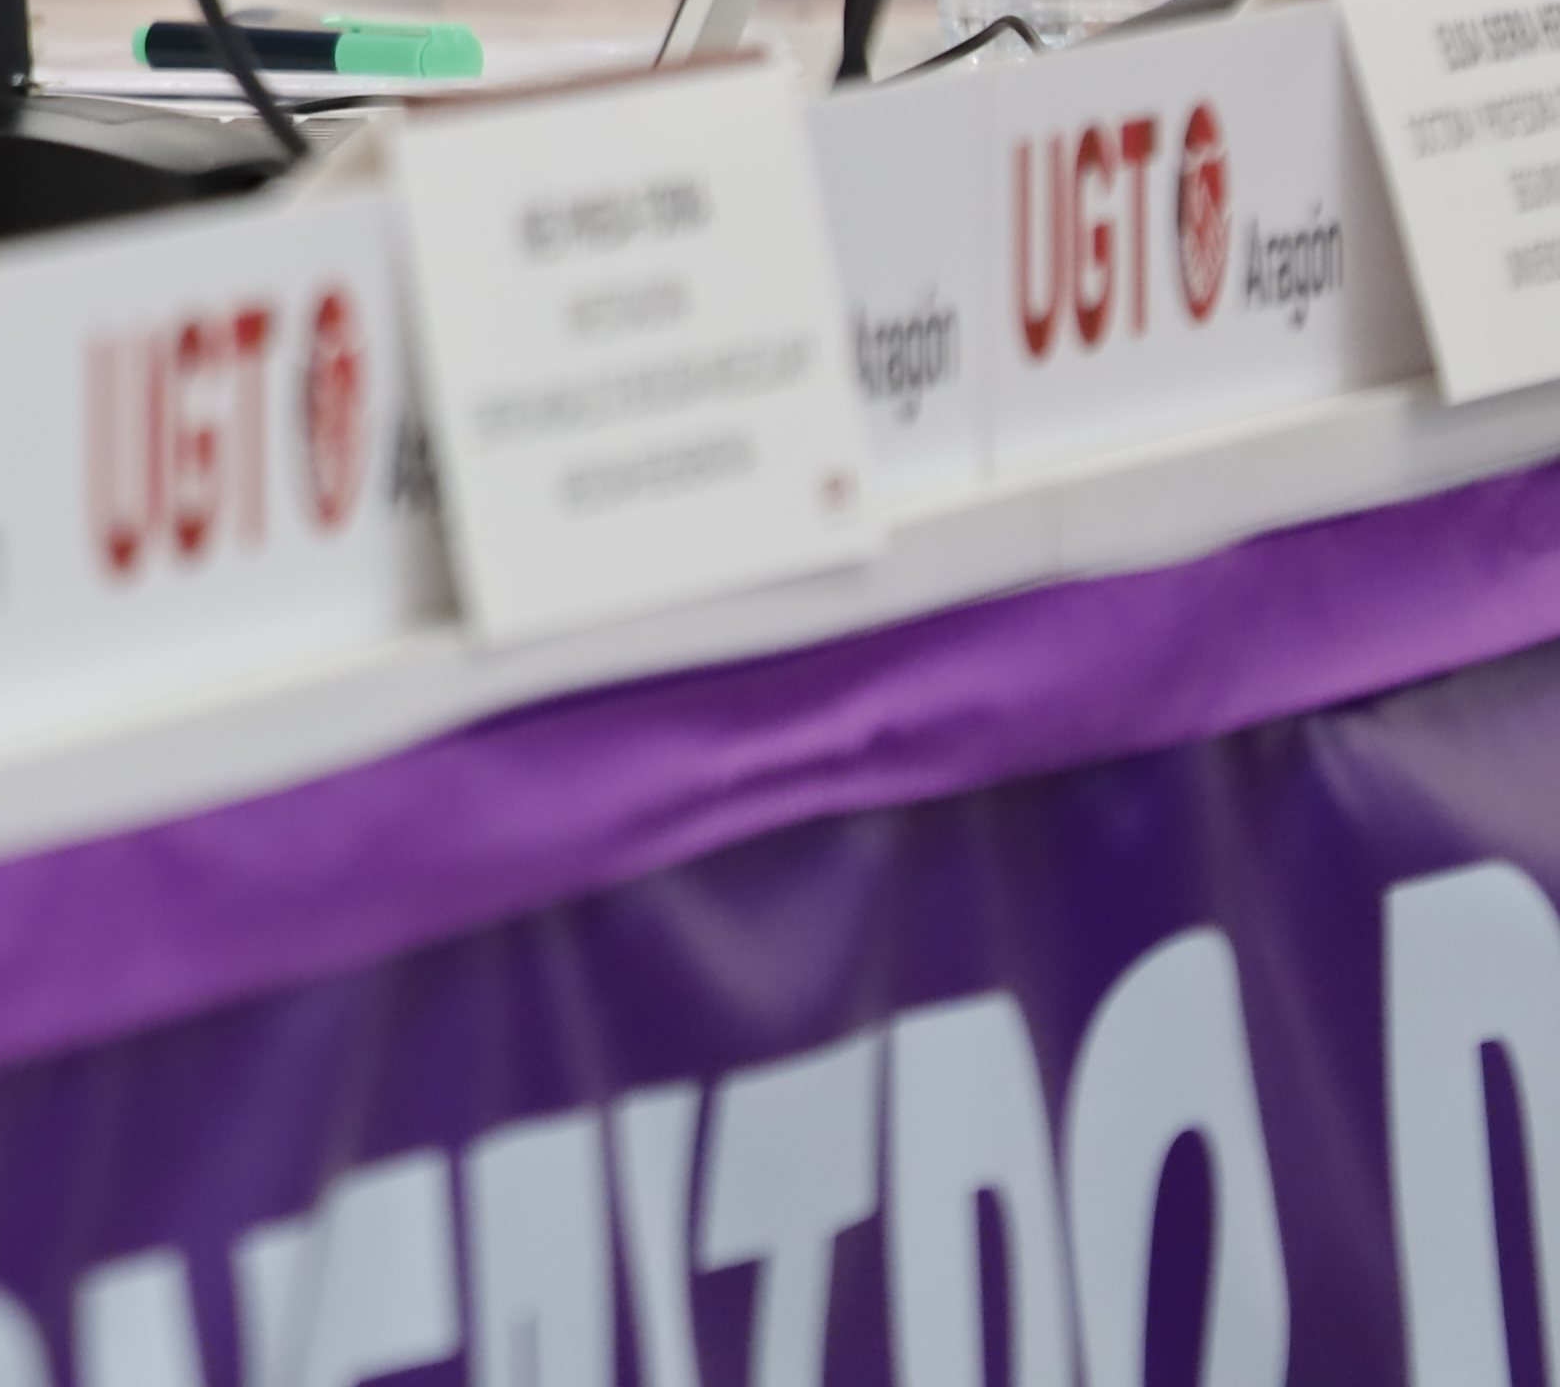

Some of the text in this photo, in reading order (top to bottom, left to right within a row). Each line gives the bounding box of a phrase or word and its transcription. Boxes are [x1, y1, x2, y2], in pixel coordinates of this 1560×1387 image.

[1014, 120, 1344, 364] UGT Aragón
[86, 305, 272, 579] UGT
